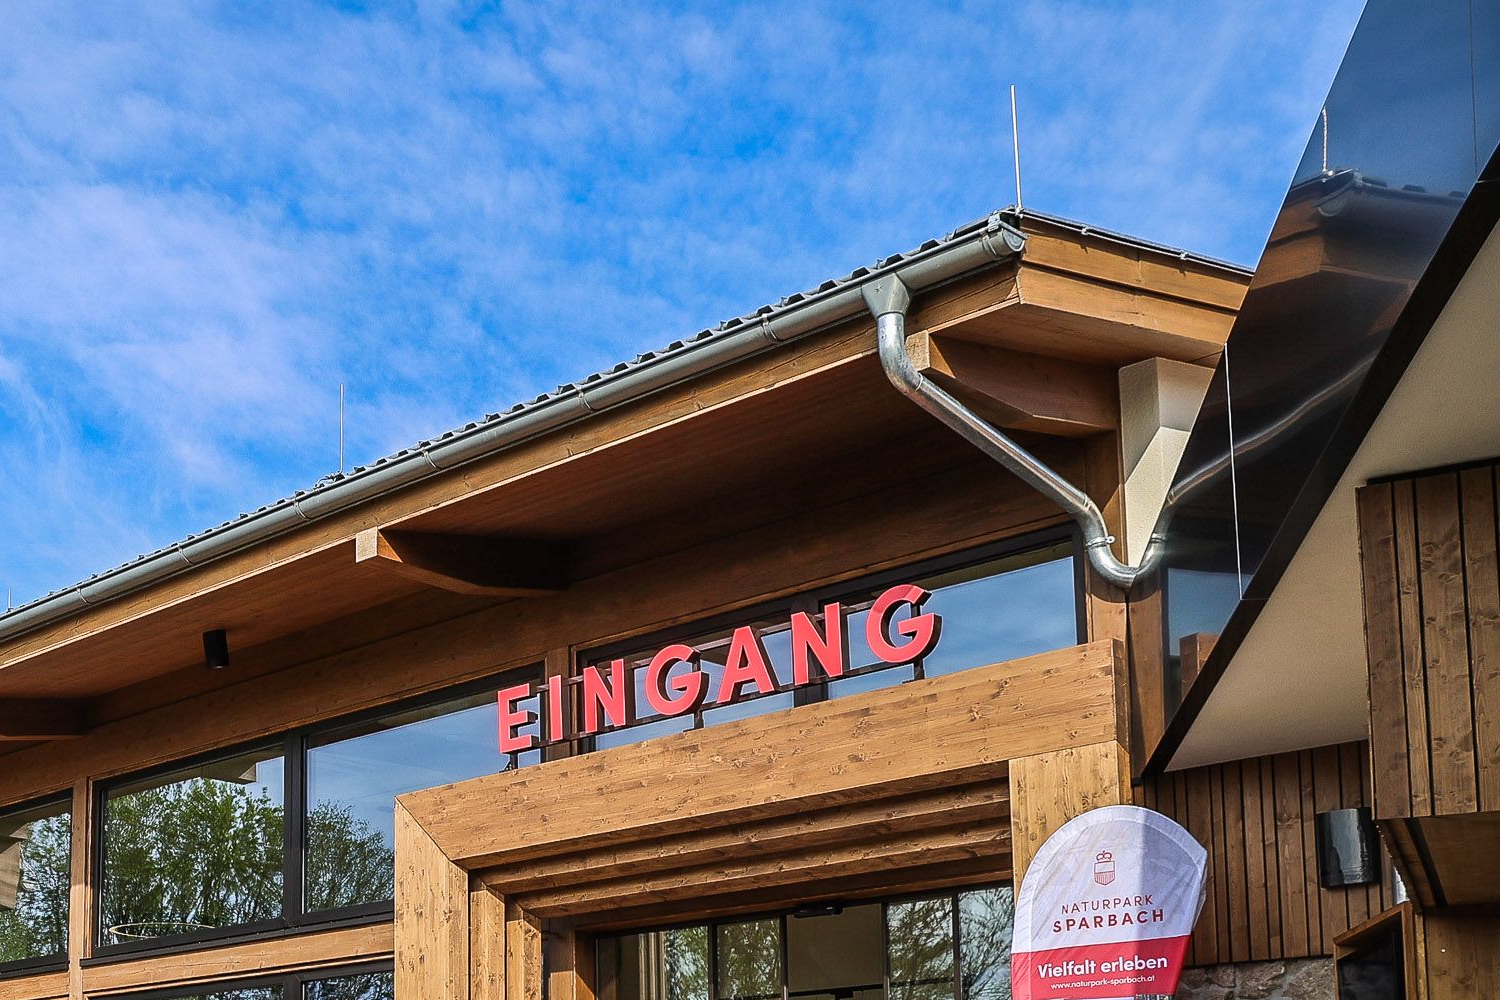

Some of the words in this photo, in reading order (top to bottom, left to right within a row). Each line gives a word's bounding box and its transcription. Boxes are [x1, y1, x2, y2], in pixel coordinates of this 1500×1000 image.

[497, 584, 942, 754] EINGANG
[1061, 894, 1154, 915] NATURPARK
[1052, 908, 1164, 933] SPARBACH
[1037, 959, 1096, 978] Vielfalt
[1100, 955, 1168, 973] erleben
[1050, 975, 1155, 989] www.naturpark-sparbach.at
